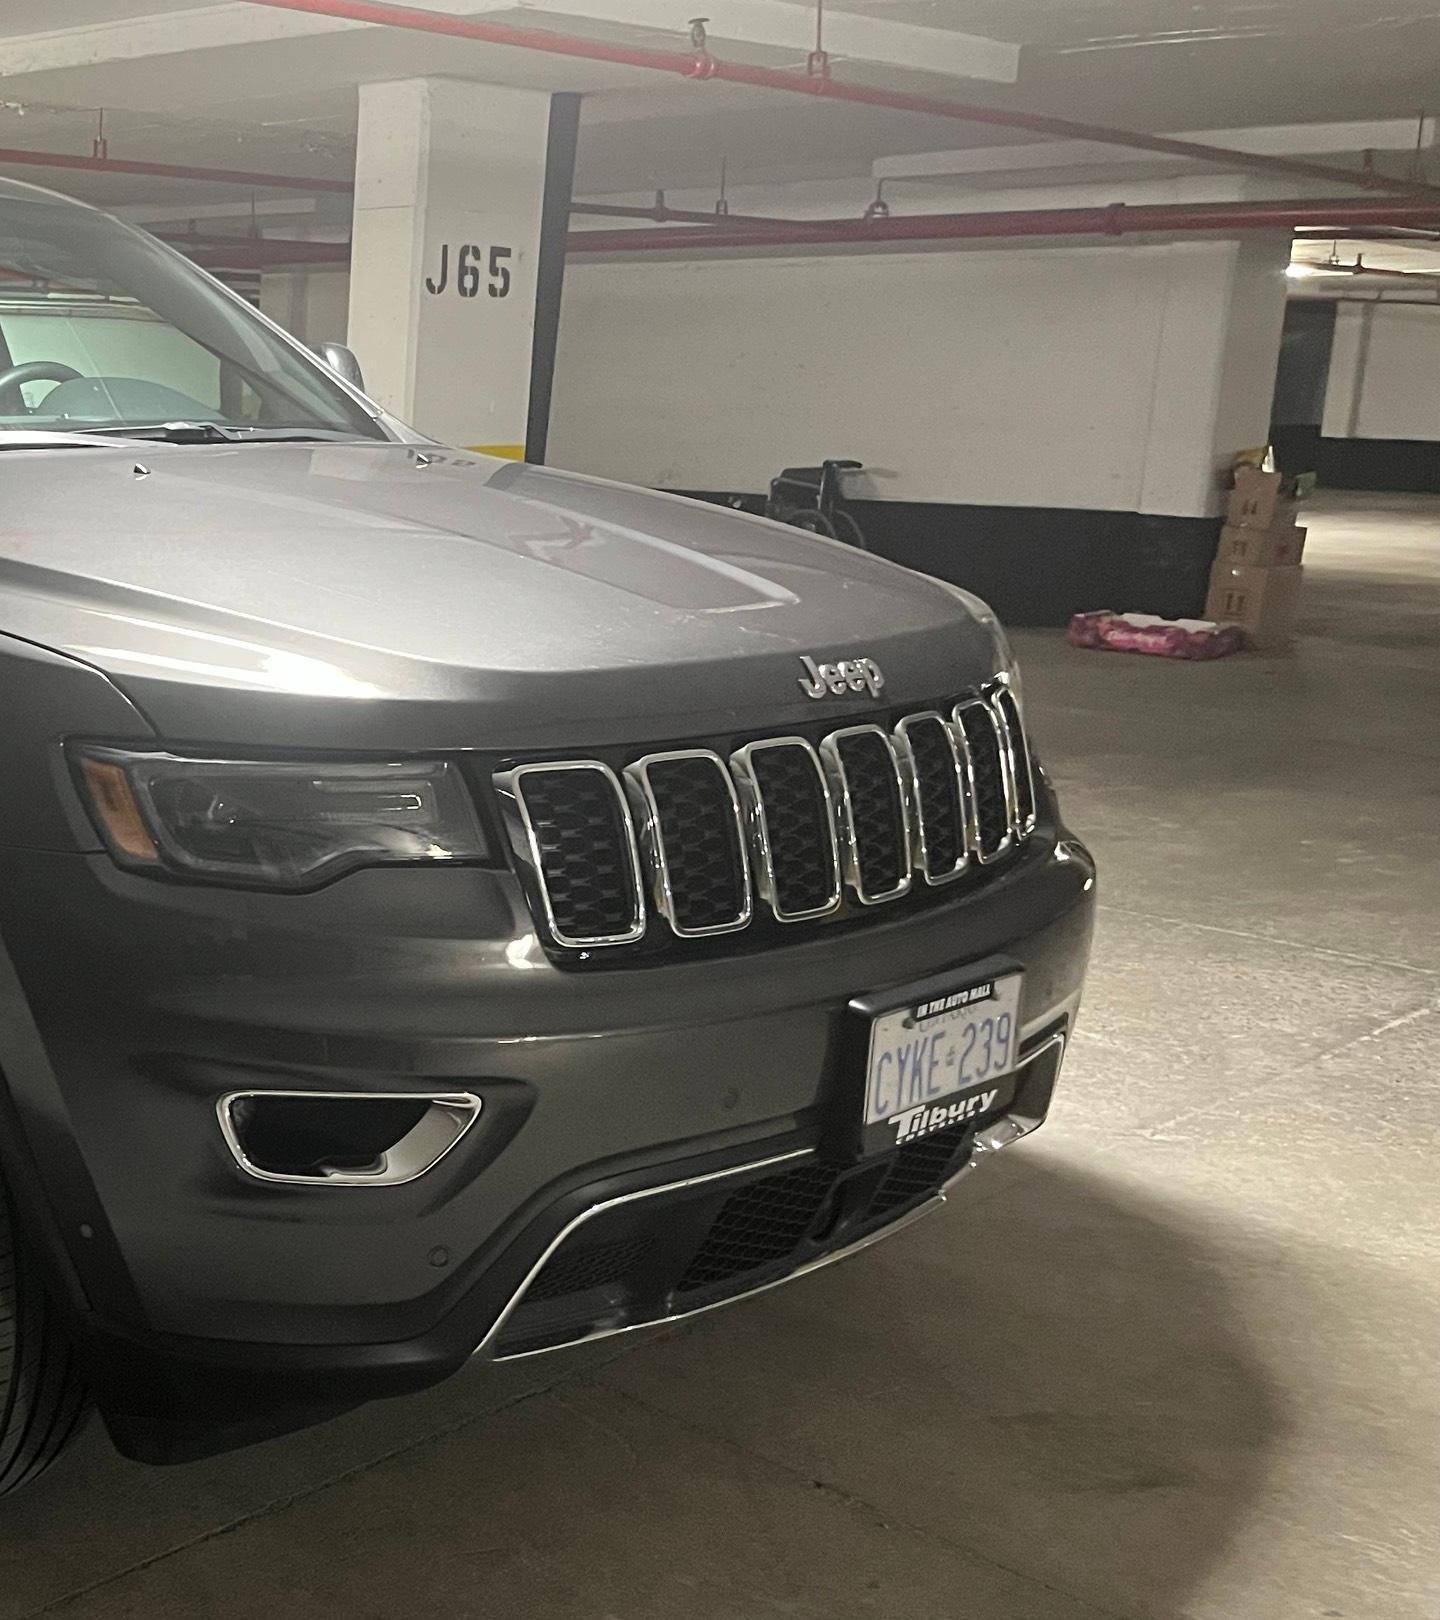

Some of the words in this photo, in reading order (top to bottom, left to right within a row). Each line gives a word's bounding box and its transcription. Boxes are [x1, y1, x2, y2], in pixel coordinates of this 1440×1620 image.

[426, 244, 512, 298] J65
[798, 655, 885, 699] Jeep
[945, 991, 969, 1009] AUTO
[873, 1031, 946, 1116] CYKE
[958, 1012, 1011, 1086] 239
[888, 1088, 999, 1139] Tilbury
